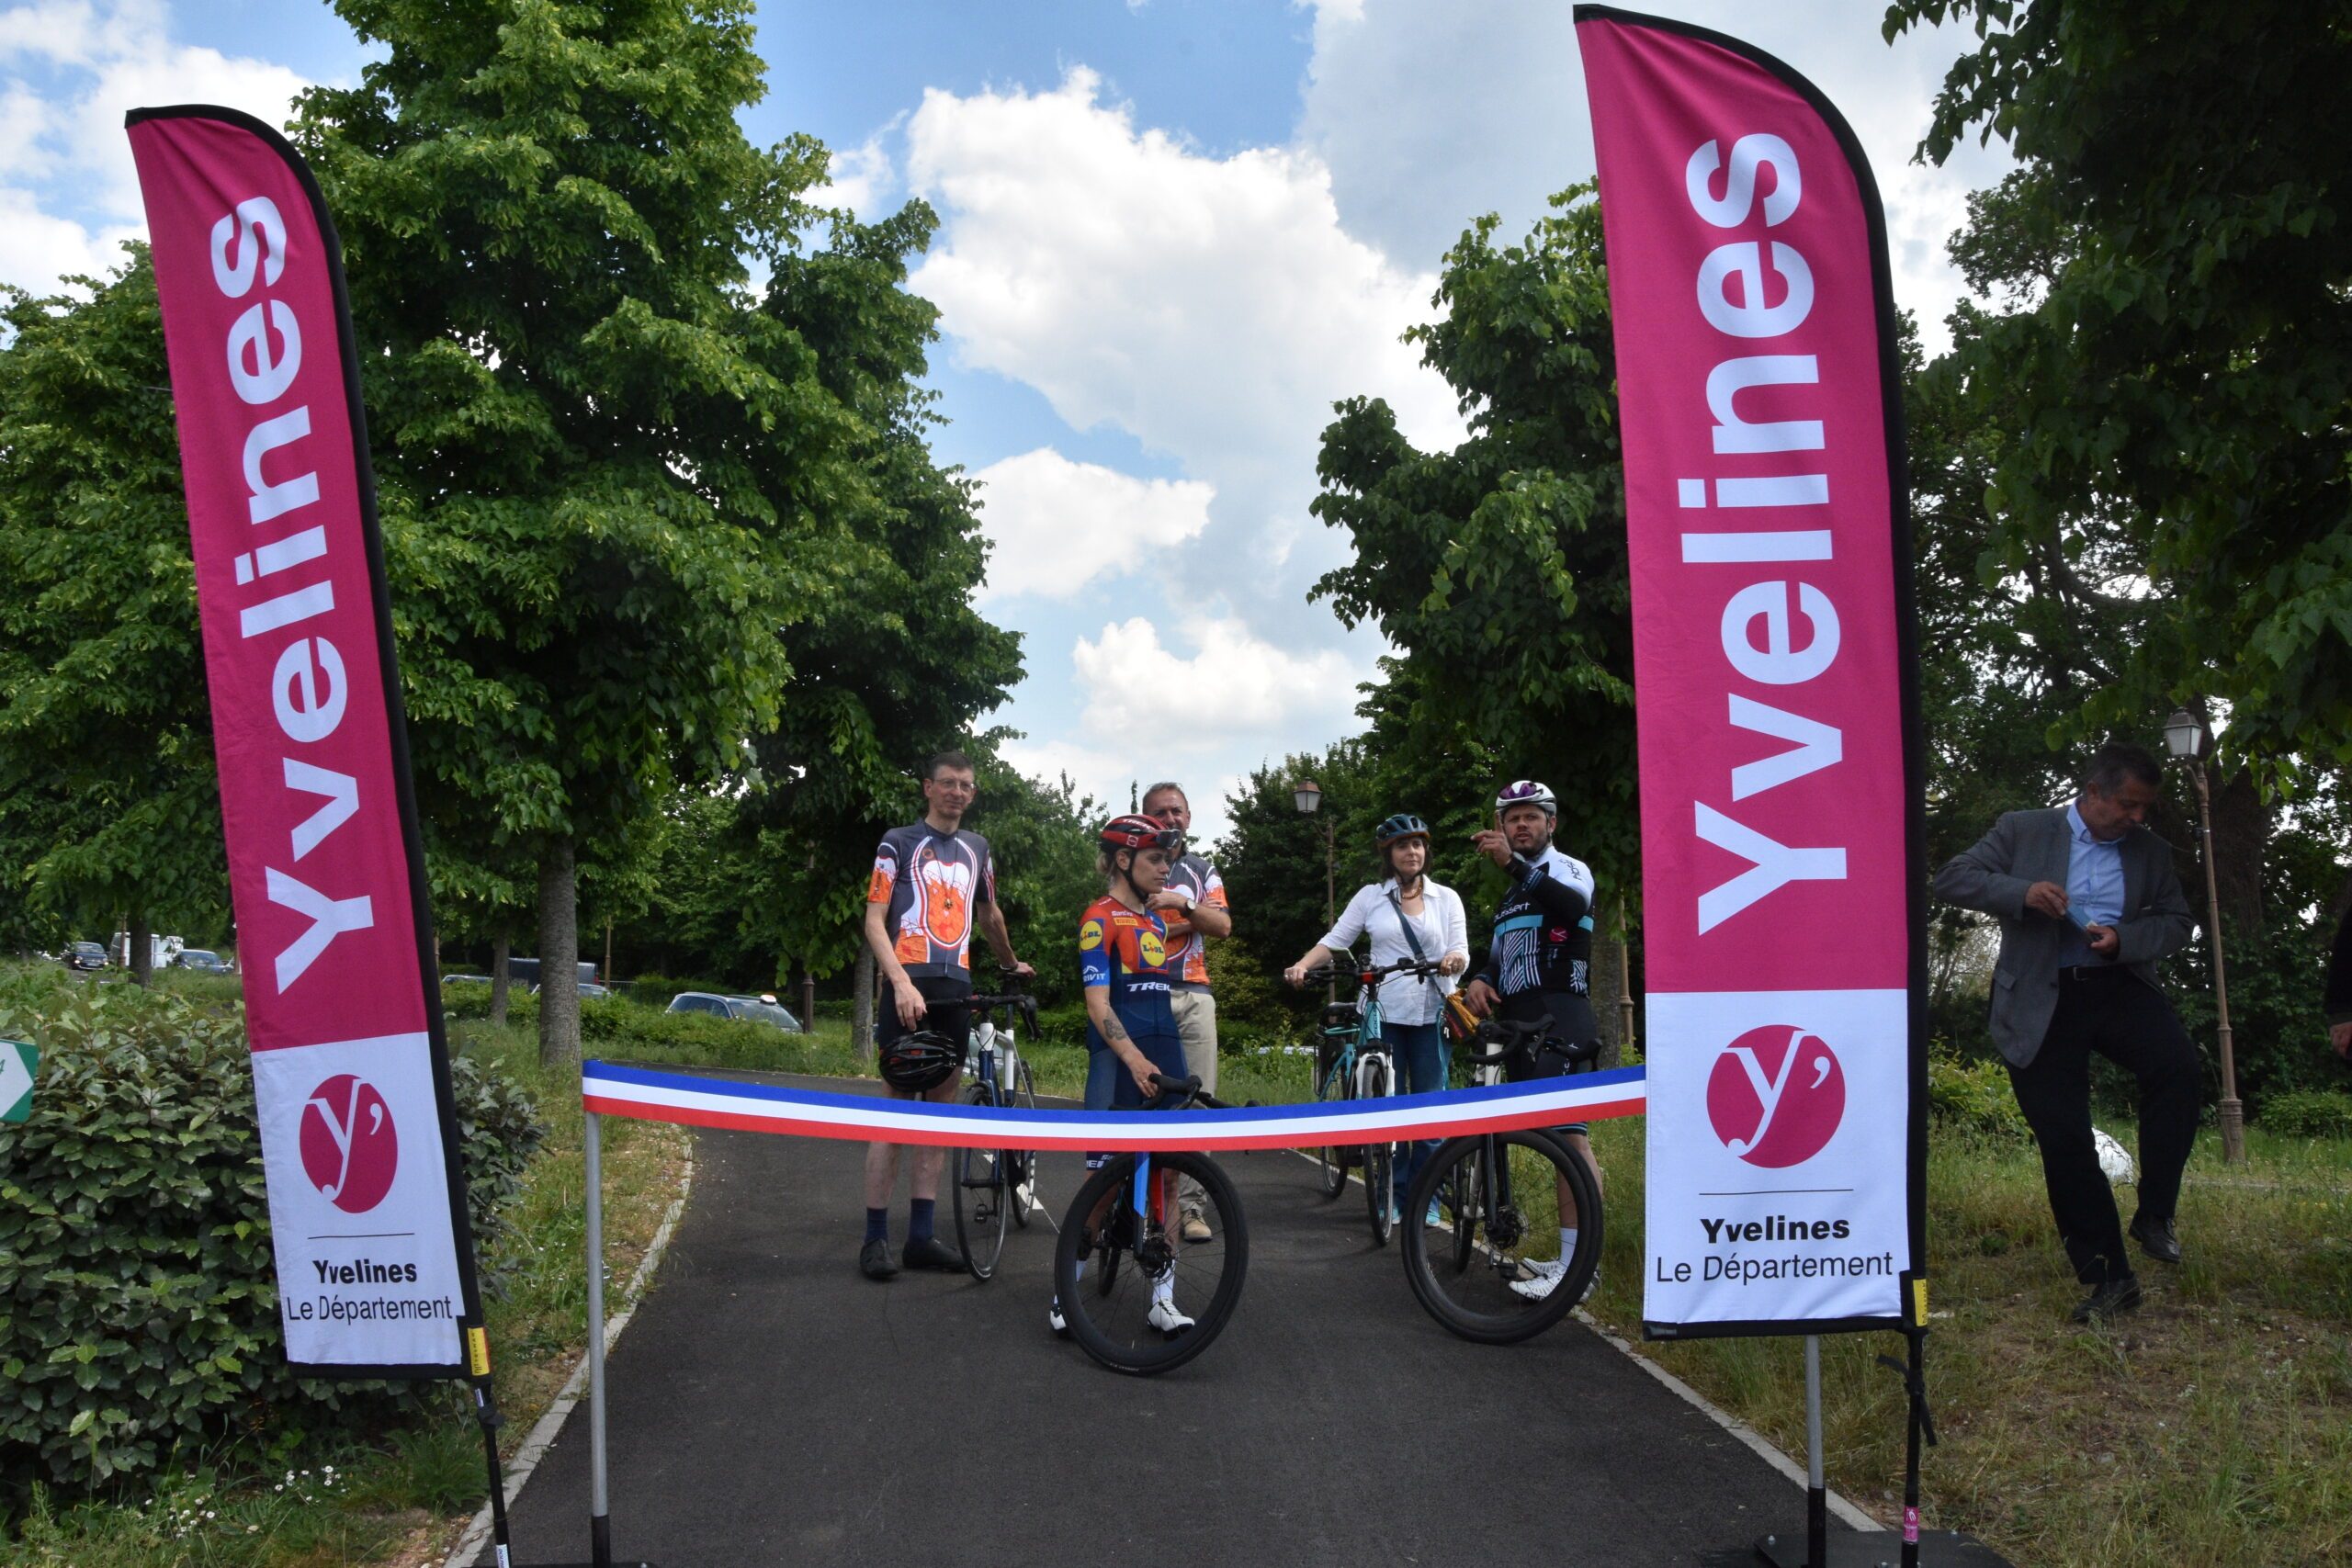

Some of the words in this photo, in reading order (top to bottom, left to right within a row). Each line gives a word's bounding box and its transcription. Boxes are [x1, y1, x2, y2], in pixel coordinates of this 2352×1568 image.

[1678, 132, 1848, 937] Yvelines
[210, 196, 374, 996] Yvelines
[1700, 1215, 1850, 1244] Yvelines
[312, 1258, 417, 1284] Yvelines
[1657, 1256, 1691, 1282] Le
[1703, 1252, 1893, 1286] Département
[287, 1296, 313, 1321] Le
[319, 1294, 453, 1325] Département
